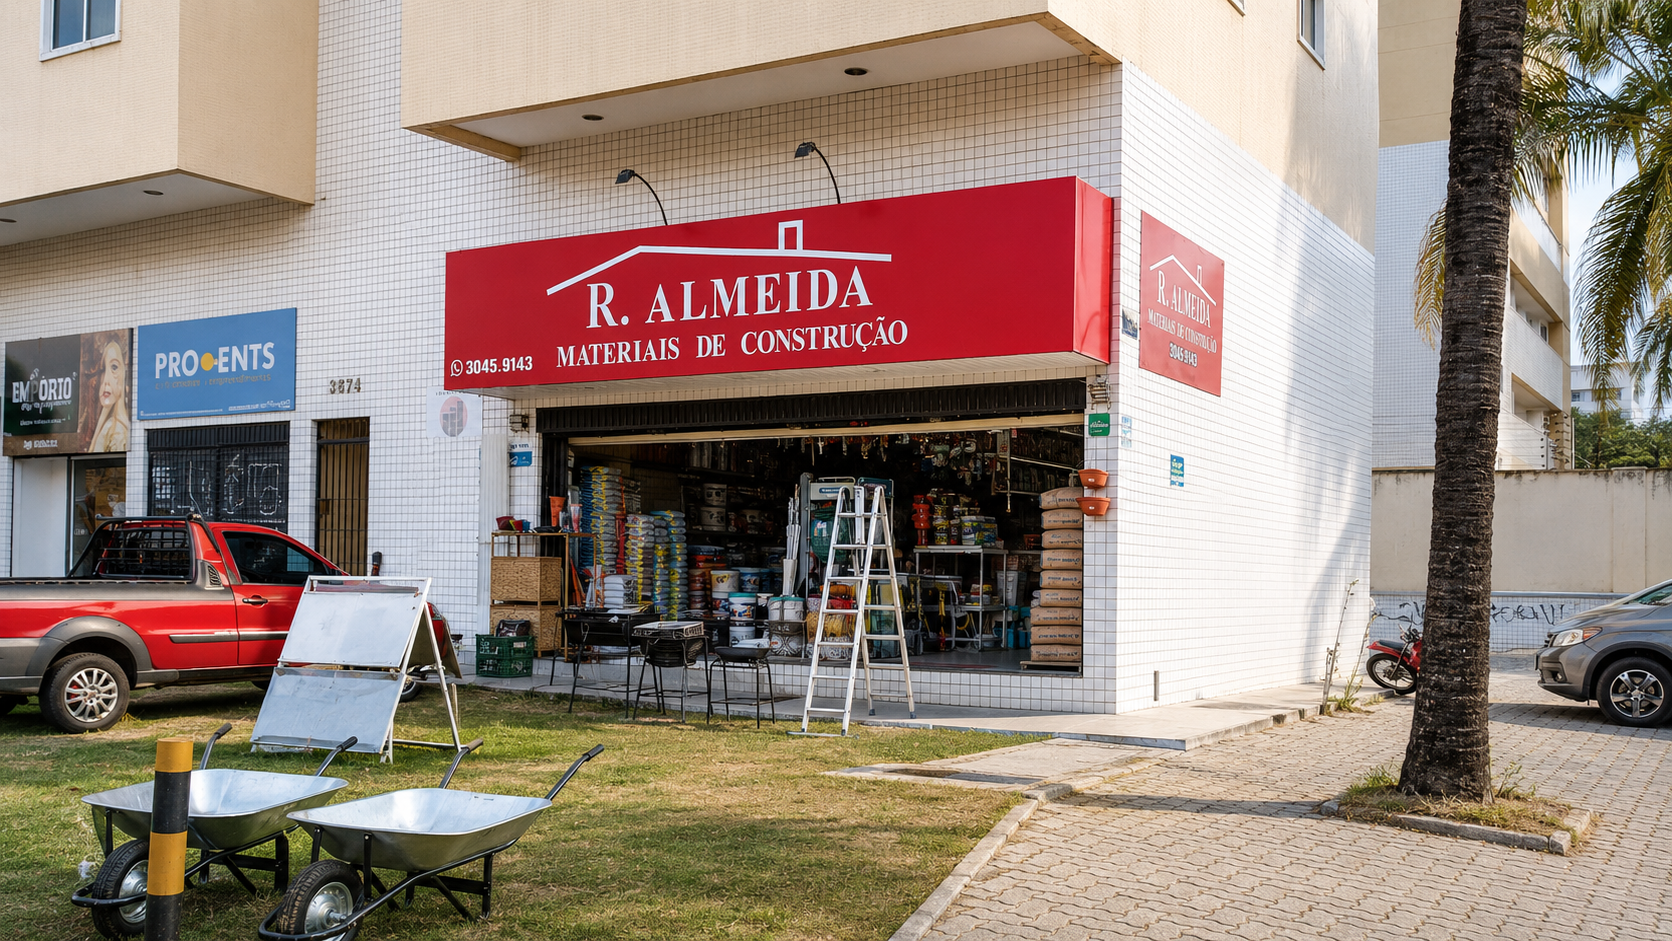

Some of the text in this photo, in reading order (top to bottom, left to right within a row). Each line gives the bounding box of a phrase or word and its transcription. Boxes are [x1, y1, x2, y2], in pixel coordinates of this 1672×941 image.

[586, 265, 873, 329] R. ALMEIDA
[1157, 269, 1211, 328] R. ALMEIDA
[465, 355, 533, 375] 3045.9143
[556, 316, 908, 368] MATERIAIS DE CONSTRUÇÃO
